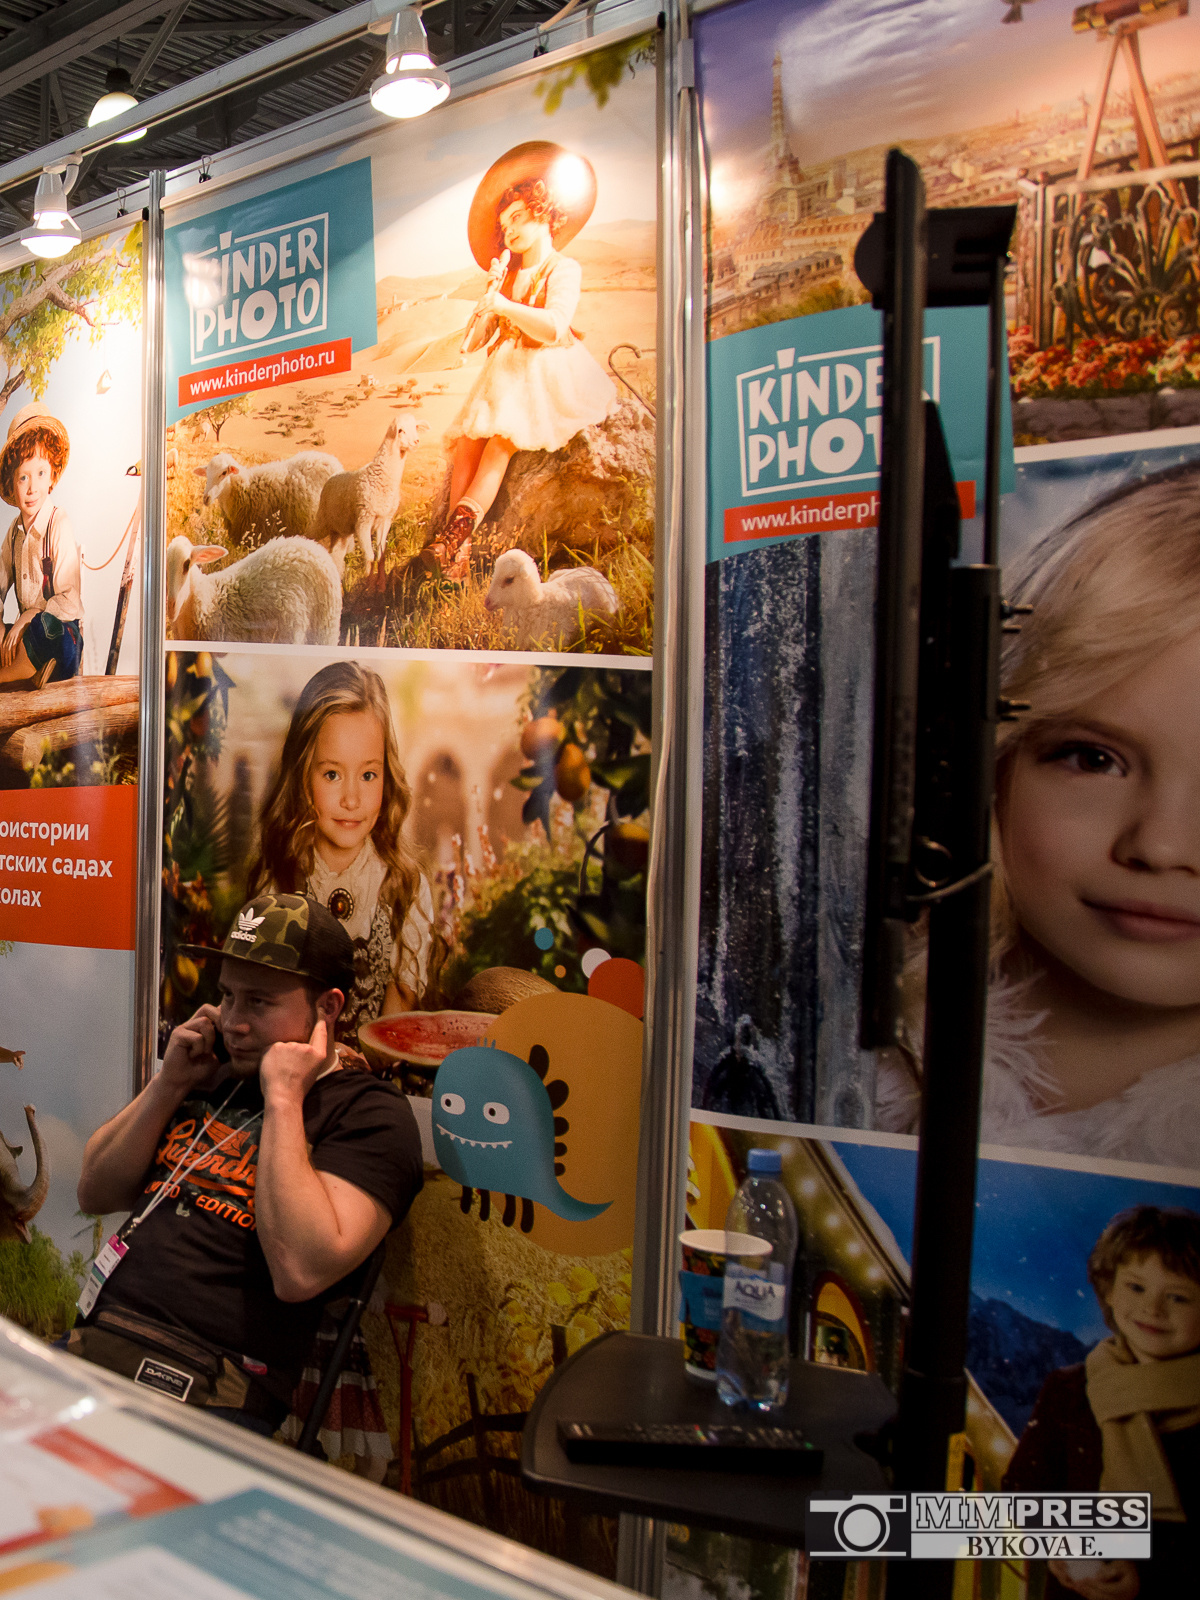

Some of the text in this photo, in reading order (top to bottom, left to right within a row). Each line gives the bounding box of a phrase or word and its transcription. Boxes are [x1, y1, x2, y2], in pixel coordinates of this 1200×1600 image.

[198, 228, 322, 297] INDER
[196, 278, 320, 352] PHOTO
[190, 350, 335, 396] www.kinderphoto.ru
[748, 348, 930, 429] KINDE
[748, 415, 883, 483] PHOT
[742, 496, 881, 532] www.kinderph
[52, 857, 113, 880] садах
[231, 931, 257, 943] adidas
[735, 1281, 776, 1300] AQUA
